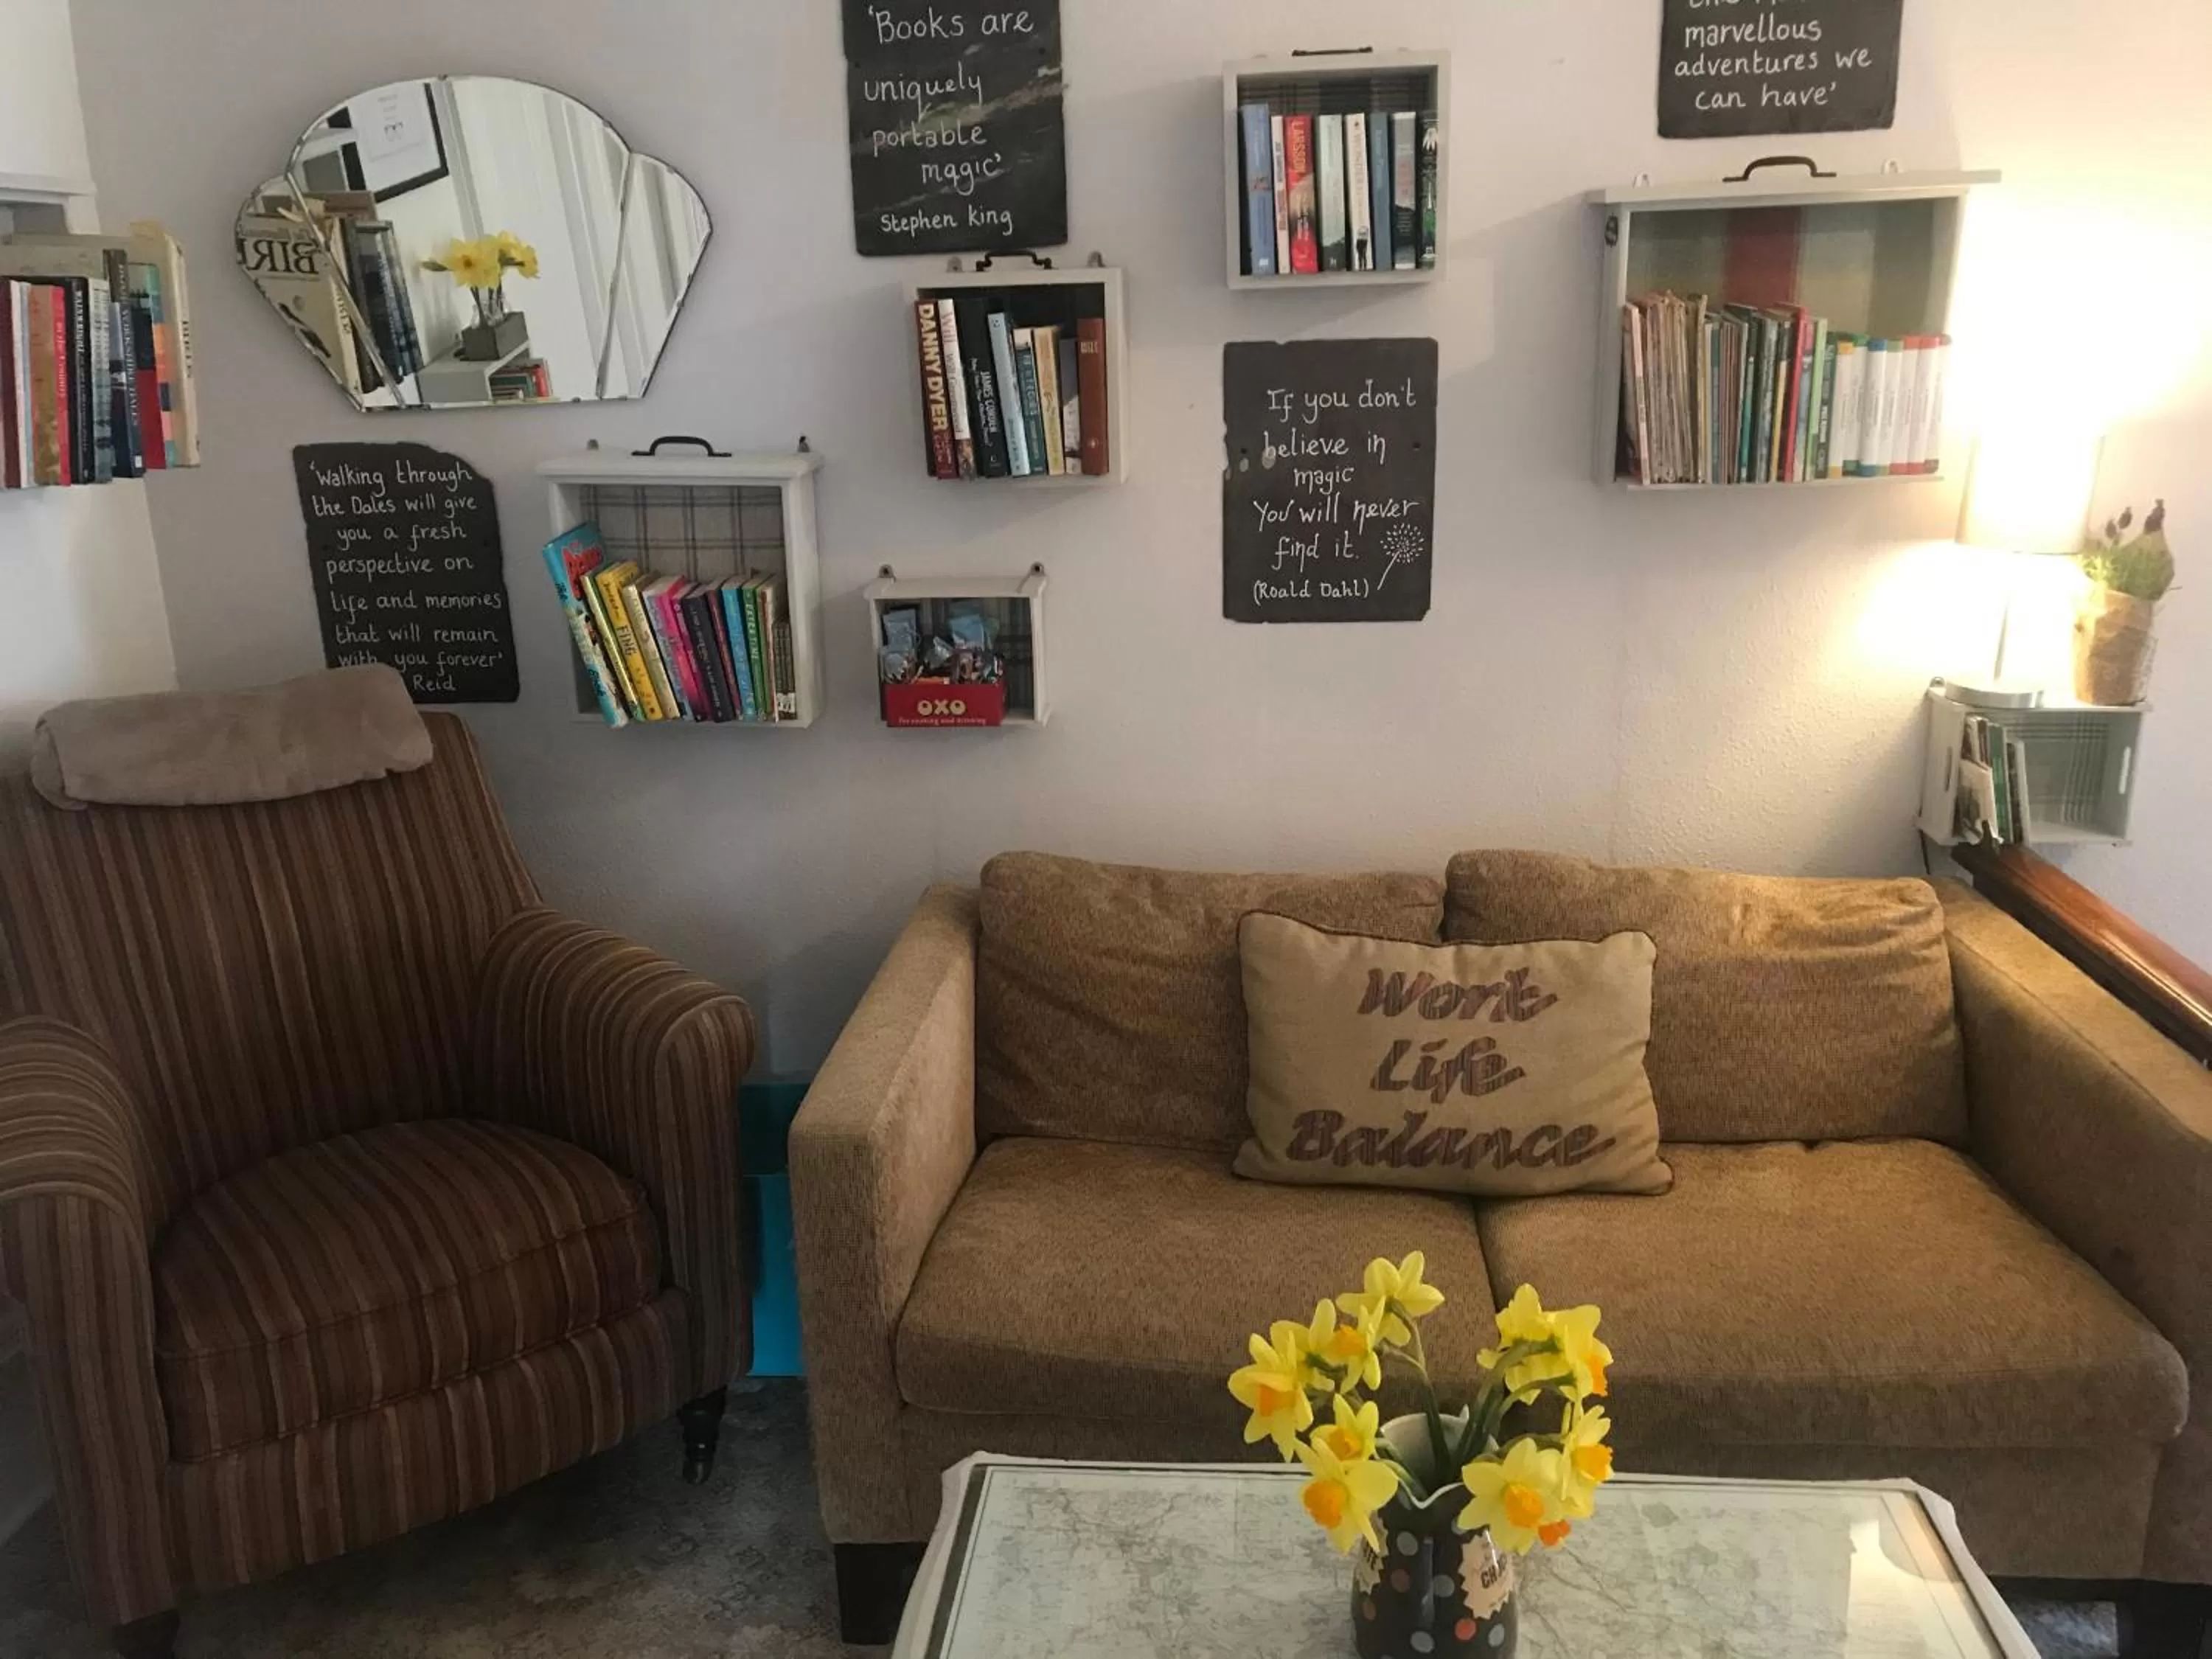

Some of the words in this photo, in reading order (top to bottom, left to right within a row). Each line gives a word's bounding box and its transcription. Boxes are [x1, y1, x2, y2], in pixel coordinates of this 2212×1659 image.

[981, 10, 1034, 35] are
[1685, 13, 1822, 47] marvellous
[1674, 49, 1819, 77] adventures
[1835, 47, 1873, 69] we
[864, 60, 983, 123] uniquely
[1695, 91, 1747, 110] can
[872, 118, 987, 157] portable
[881, 209, 957, 239] Stephen
[918, 304, 942, 374] DANNY
[927, 377, 947, 431] DYER
[1267, 388, 1294, 422] If
[1302, 392, 1349, 424] you
[1358, 378, 1416, 408] don't
[1264, 427, 1349, 458] believe
[1368, 431, 1386, 465] in
[396, 459, 473, 492] through
[1293, 467, 1354, 495] magic
[312, 495, 345, 516] the
[350, 495, 397, 515] Dales
[406, 493, 437, 511] will
[445, 495, 478, 518] give
[1299, 491, 1341, 524] will
[1353, 498, 1421, 536] never
[337, 526, 372, 551] you
[383, 527, 399, 540] a
[410, 522, 467, 552] fresh
[1271, 532, 1320, 573] find
[326, 553, 434, 585] perspective
[445, 556, 475, 570] on
[376, 591, 417, 608] and
[425, 592, 503, 611] memories
[1254, 580, 1311, 606] (Roald
[1321, 579, 1369, 599] Dahl)
[335, 625, 380, 644] that
[389, 623, 420, 643] will
[434, 628, 499, 643] remain
[338, 650, 378, 667] with
[394, 653, 428, 672] you
[413, 674, 457, 692] Reid
[917, 699, 967, 716] OXO
[1356, 966, 1558, 1023] Work
[1370, 1036, 1526, 1105] Life
[1285, 1109, 1617, 1169] Balance
